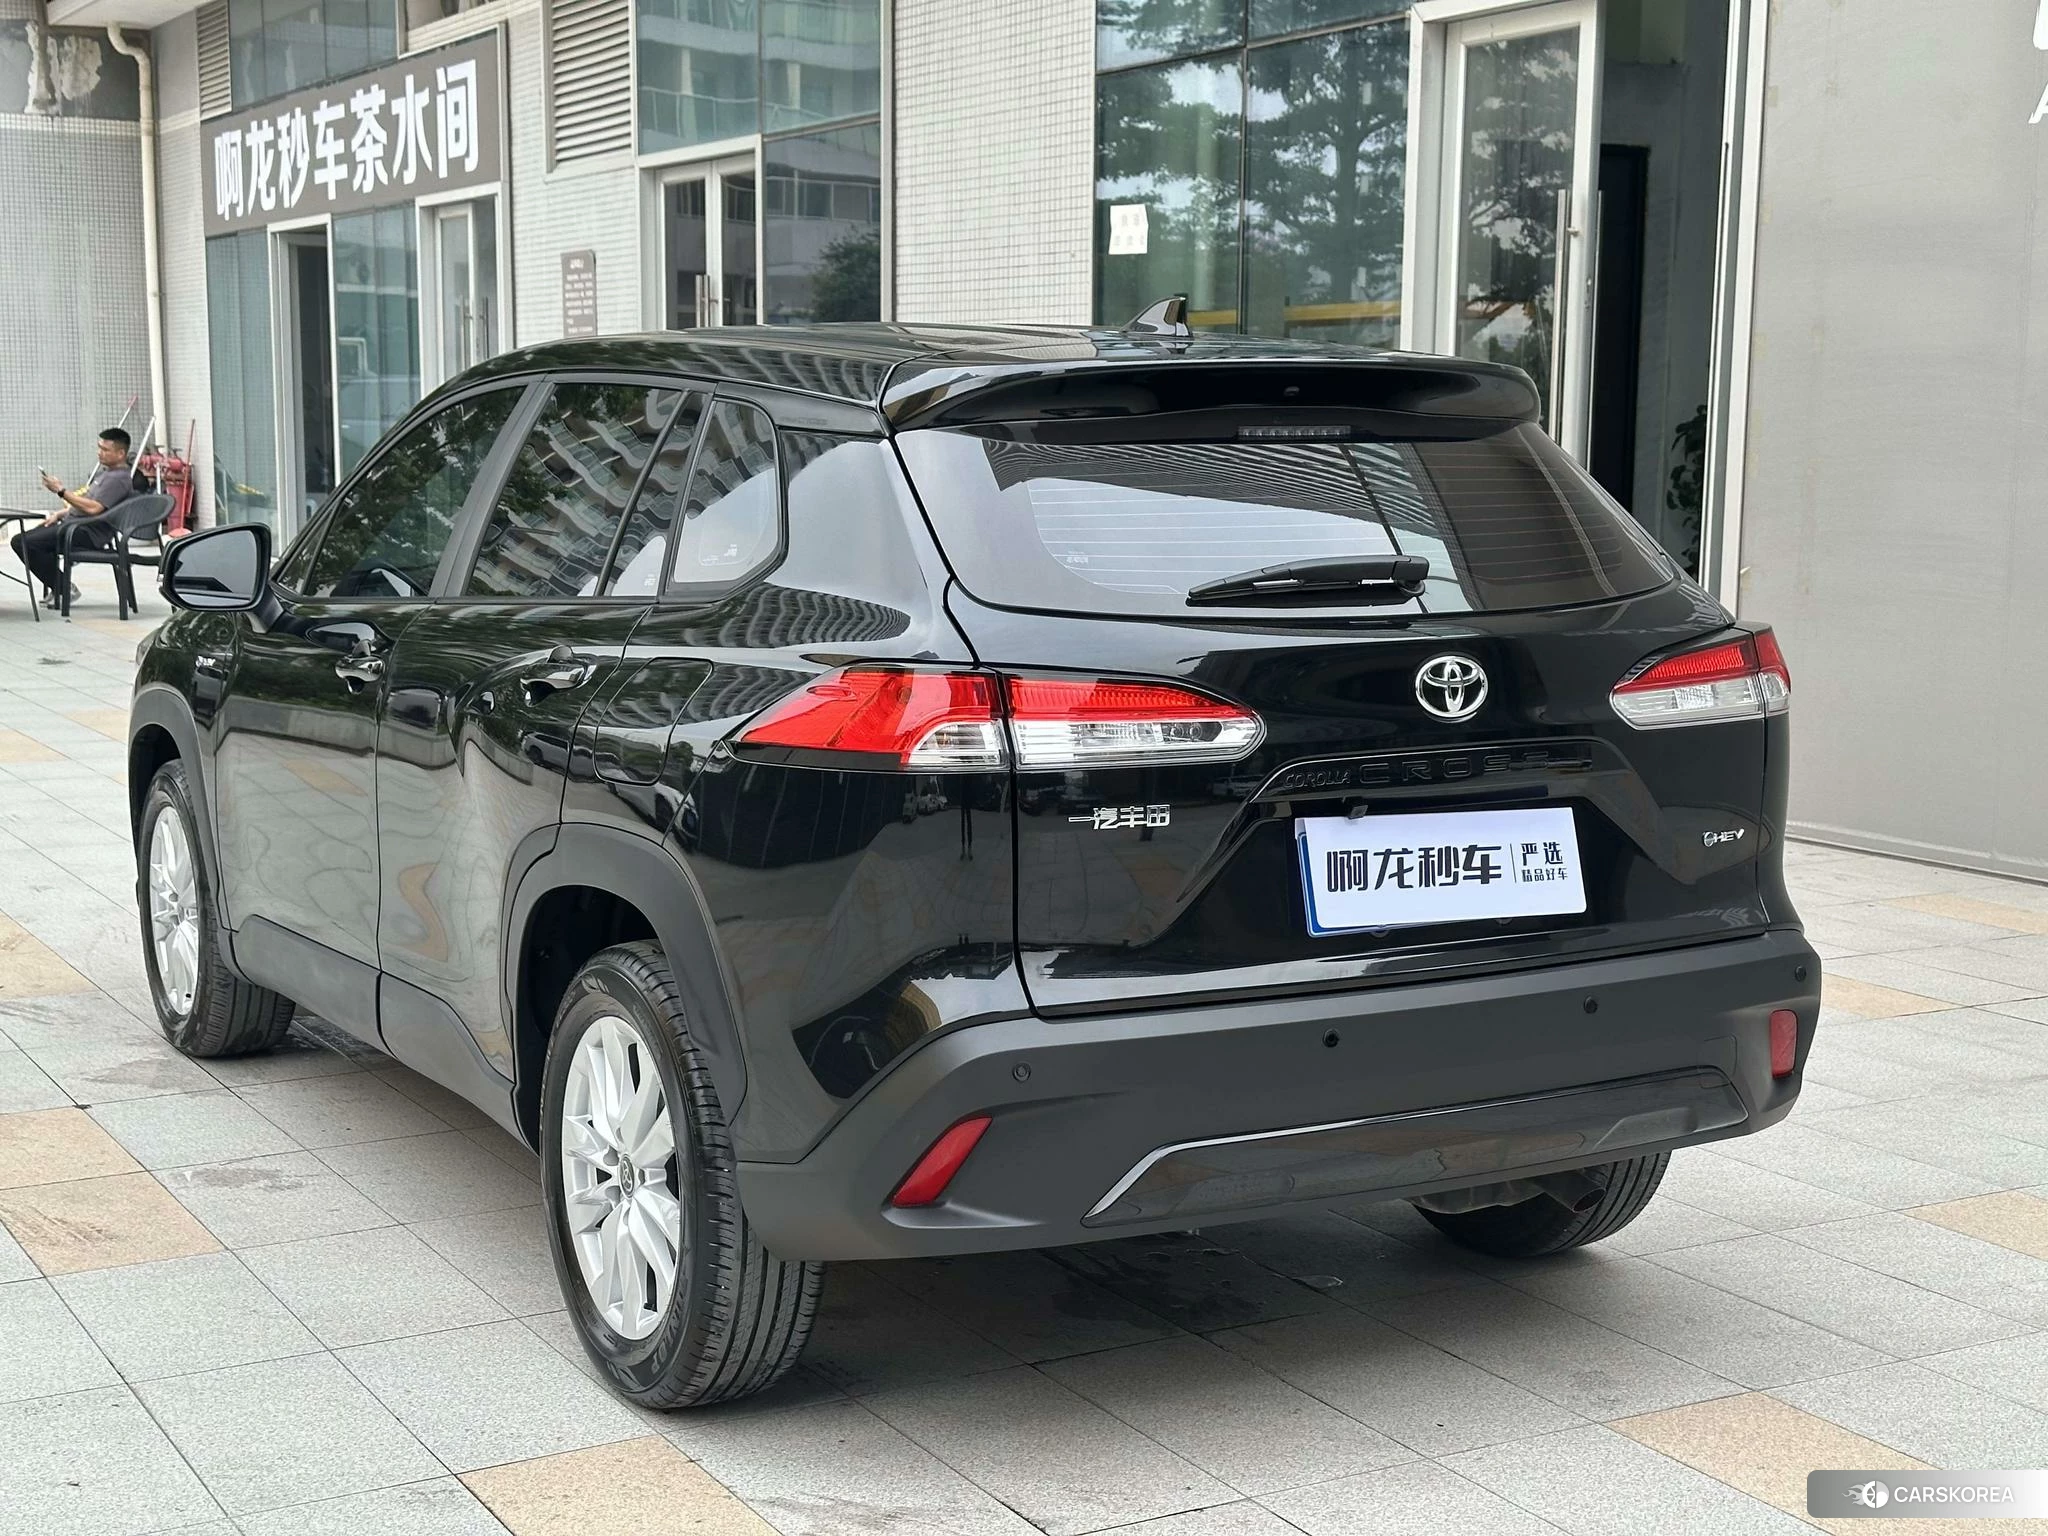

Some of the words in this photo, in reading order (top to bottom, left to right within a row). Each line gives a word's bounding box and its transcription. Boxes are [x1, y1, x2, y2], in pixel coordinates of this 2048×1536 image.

[214, 59, 479, 221] 啊龙秒车茶水间
[1284, 770, 1350, 789] COROLLA
[1521, 841, 1564, 867] 严选
[1326, 844, 1502, 893] 啊龙秒车
[1521, 867, 1568, 883] 精品好车
